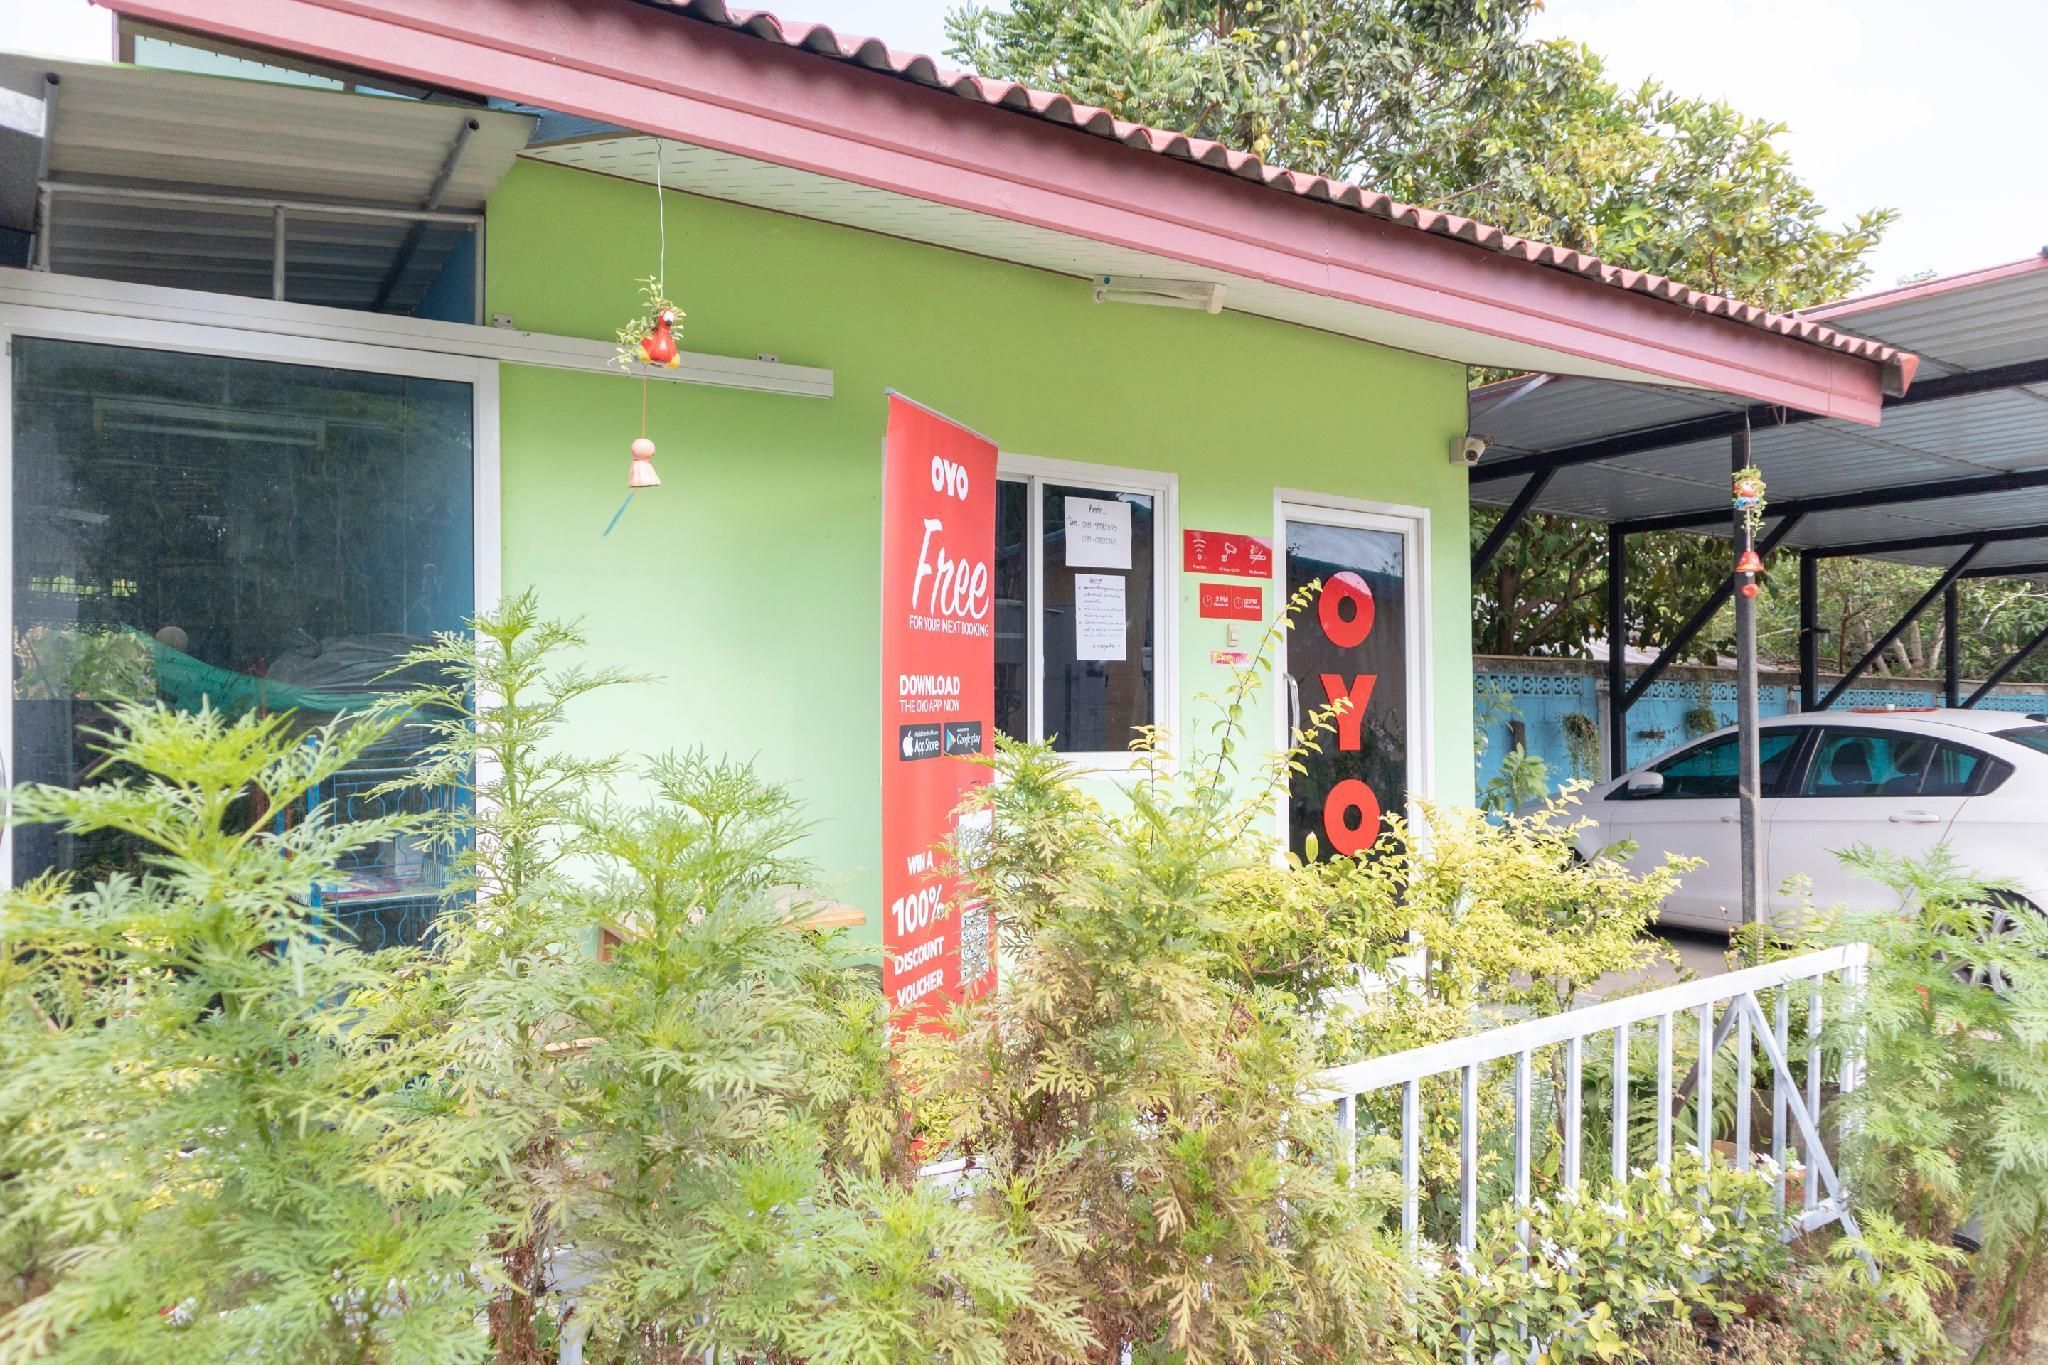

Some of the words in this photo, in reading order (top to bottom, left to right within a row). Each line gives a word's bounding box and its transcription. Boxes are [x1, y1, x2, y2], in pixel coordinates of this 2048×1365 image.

[932, 455, 969, 501] OYO
[912, 518, 989, 620] Free
[909, 615, 923, 630] FOR
[924, 616, 941, 632] YOUR
[942, 619, 961, 634] NEXT
[961, 621, 989, 637] BOOKING
[899, 675, 960, 696] DOWNLOAD
[899, 699, 916, 713] THE
[929, 699, 943, 713] APP
[943, 699, 960, 712] NOW
[1318, 571, 1381, 857] OYO
[914, 739, 925, 756] App
[925, 738, 939, 752] Store
[907, 852, 926, 875] WIN
[926, 850, 934, 869] A
[892, 884, 945, 936] 100%
[894, 936, 945, 976] DISCOUNT
[896, 968, 945, 1009] VOUCHER
